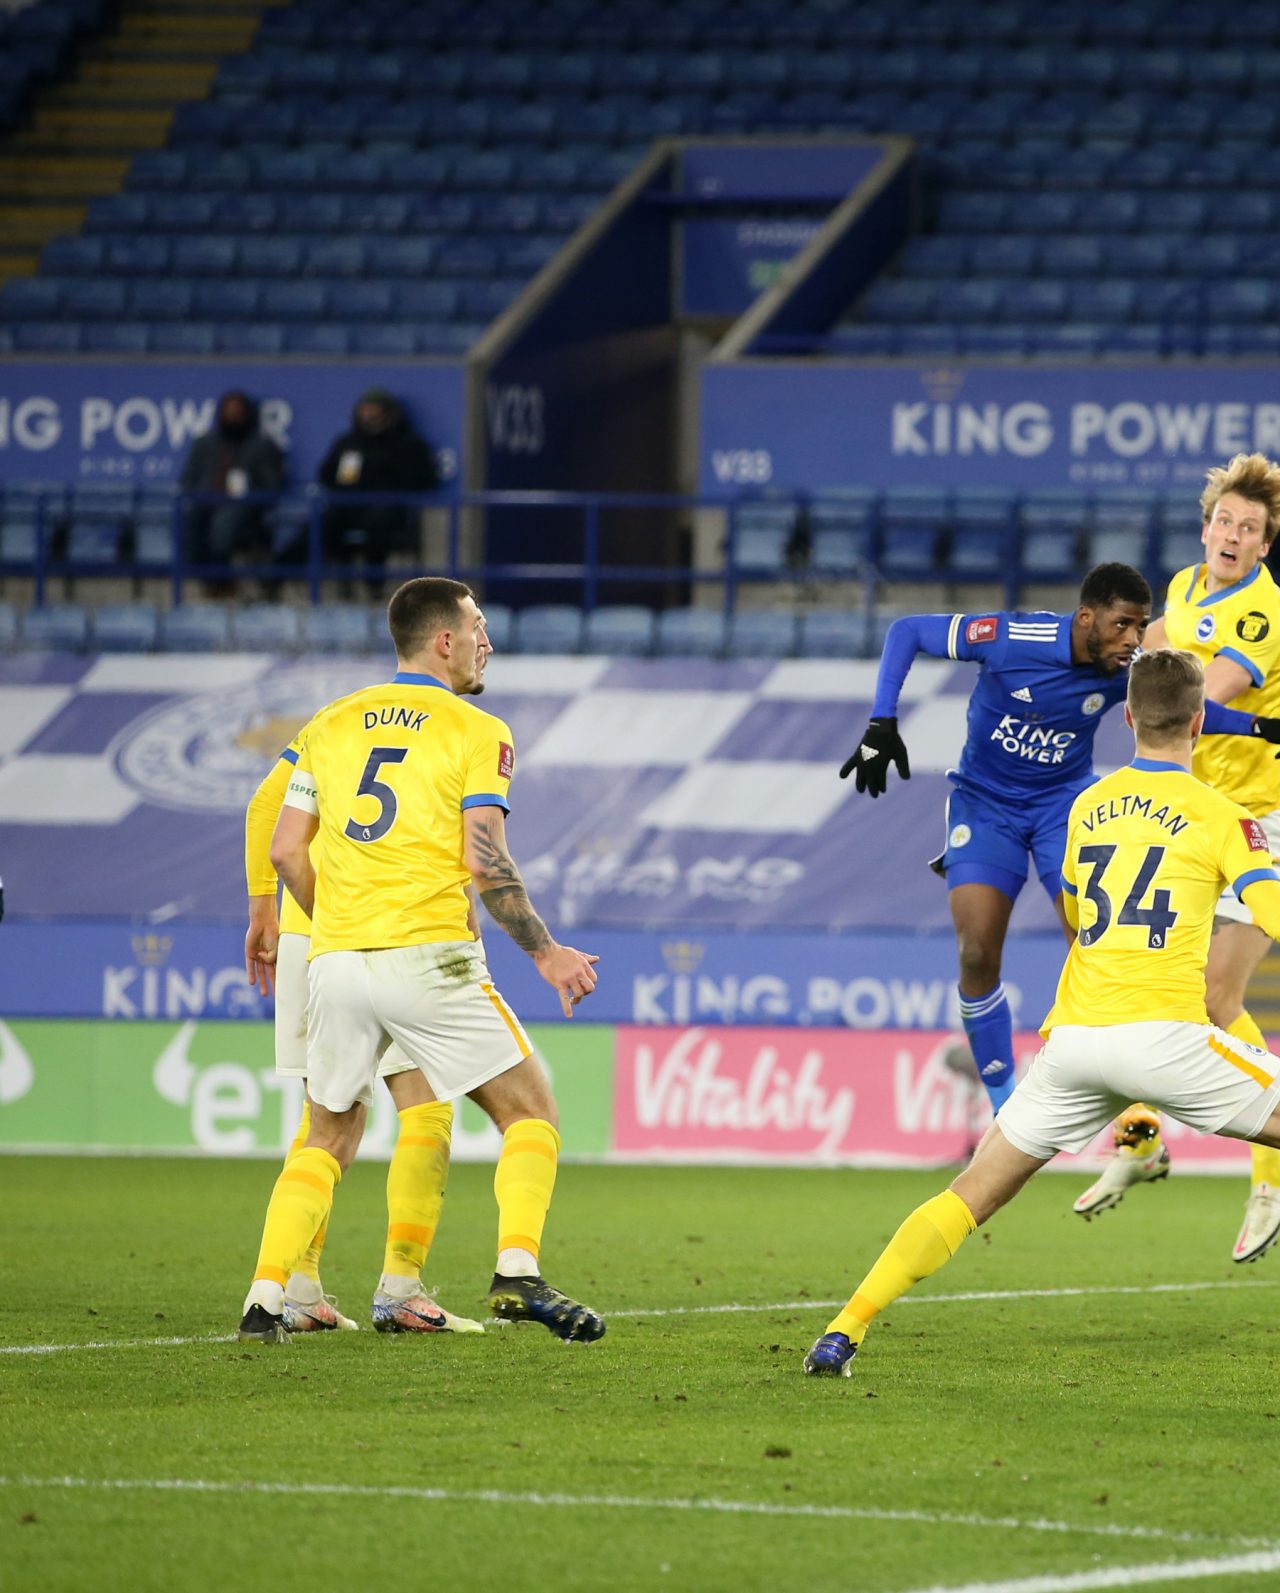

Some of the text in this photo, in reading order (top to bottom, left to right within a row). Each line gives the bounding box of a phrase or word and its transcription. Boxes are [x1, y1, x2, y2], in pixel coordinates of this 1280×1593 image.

[80, 397, 294, 452] POWR
[892, 402, 1053, 457] KING
[364, 707, 429, 732] DUNK
[998, 714, 1076, 749] KING
[990, 728, 1065, 764] POWER
[289, 782, 318, 798] ESPEC
[344, 747, 408, 843] 5
[1082, 795, 1189, 836] VELTMAN
[1077, 844, 1178, 949] 34
[632, 974, 791, 1026] KING
[633, 1028, 856, 1160] Vitality
